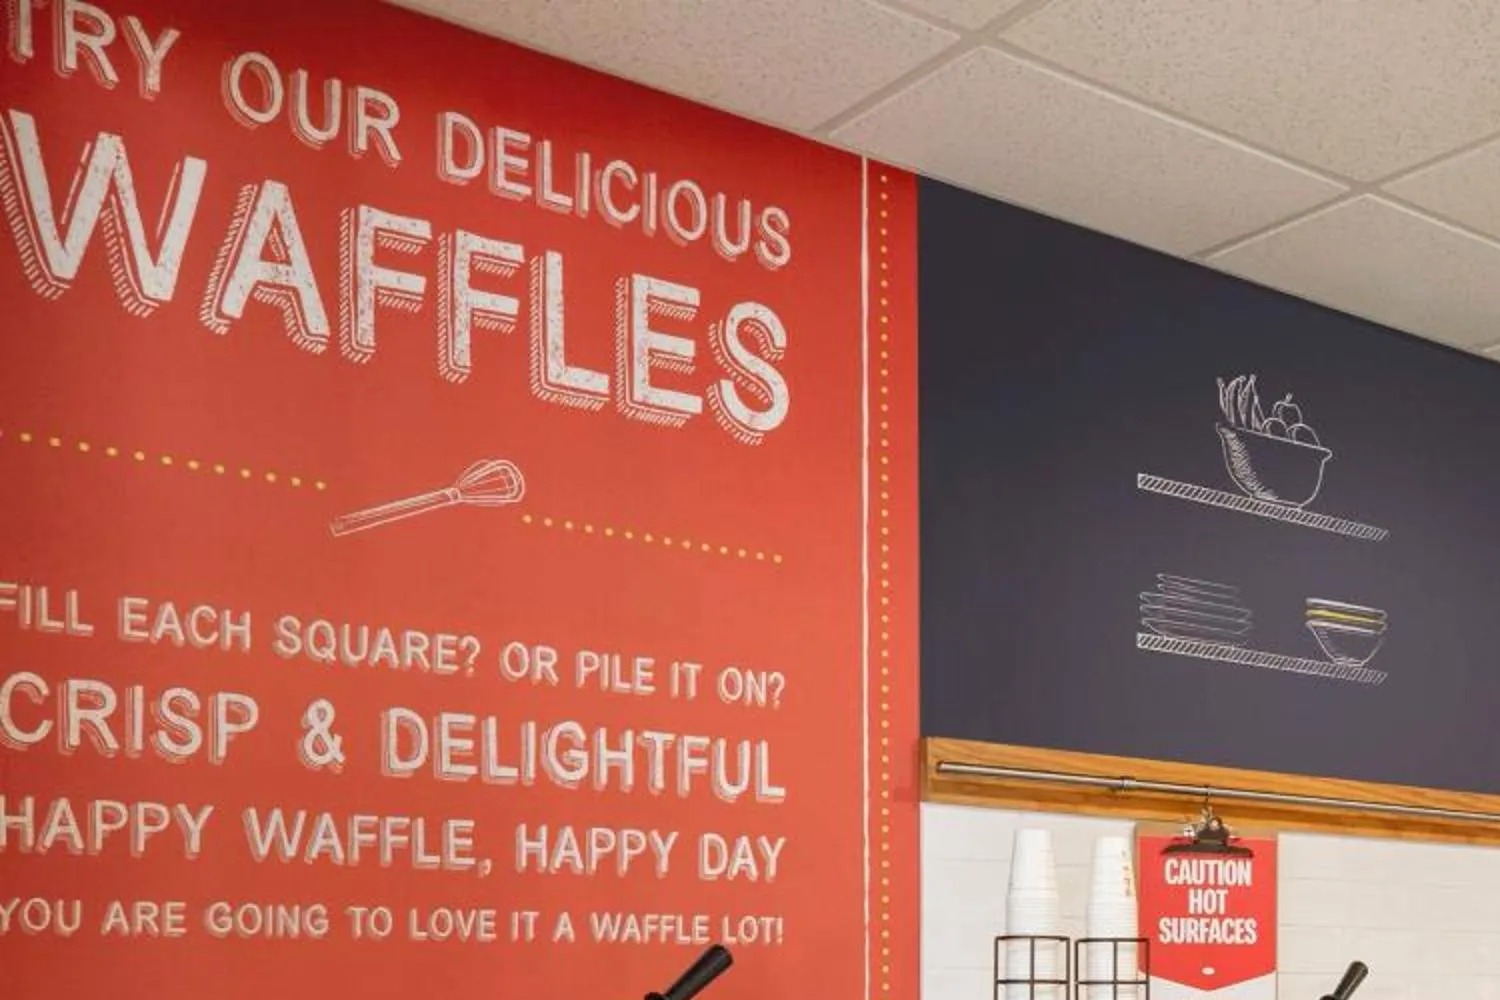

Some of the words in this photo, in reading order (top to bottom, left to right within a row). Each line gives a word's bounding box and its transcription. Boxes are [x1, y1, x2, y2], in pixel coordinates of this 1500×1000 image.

[222, 51, 402, 166] OUR
[437, 111, 793, 271] DELICIOUS
[0, 109, 791, 446] WAFFLES
[117, 596, 251, 650] EACH
[272, 615, 481, 677] SQUARE?
[500, 641, 558, 686] OR
[577, 650, 654, 696] PILE
[670, 661, 703, 699] IT
[718, 667, 786, 709] ON?
[0, 671, 259, 764] CRISP
[297, 698, 345, 772] &
[380, 707, 786, 801] DELIGHTFUL
[0, 794, 214, 860] HAPPY
[242, 807, 492, 877] WAFFLE,
[515, 824, 678, 878] HAPPY
[699, 833, 785, 882] DAY
[1164, 858, 1252, 886] CAUTION
[0, 897, 82, 938] YOU
[100, 901, 187, 938] ARE
[205, 902, 330, 938] GOING
[351, 905, 393, 938] TO
[409, 907, 496, 942] LOVE
[511, 910, 540, 942] IT
[553, 911, 575, 943] A
[591, 911, 709, 945] WAFFLE
[721, 913, 784, 945] LOT!
[1159, 917, 1257, 945] SURFACES
[1188, 888, 1228, 914] HOT
